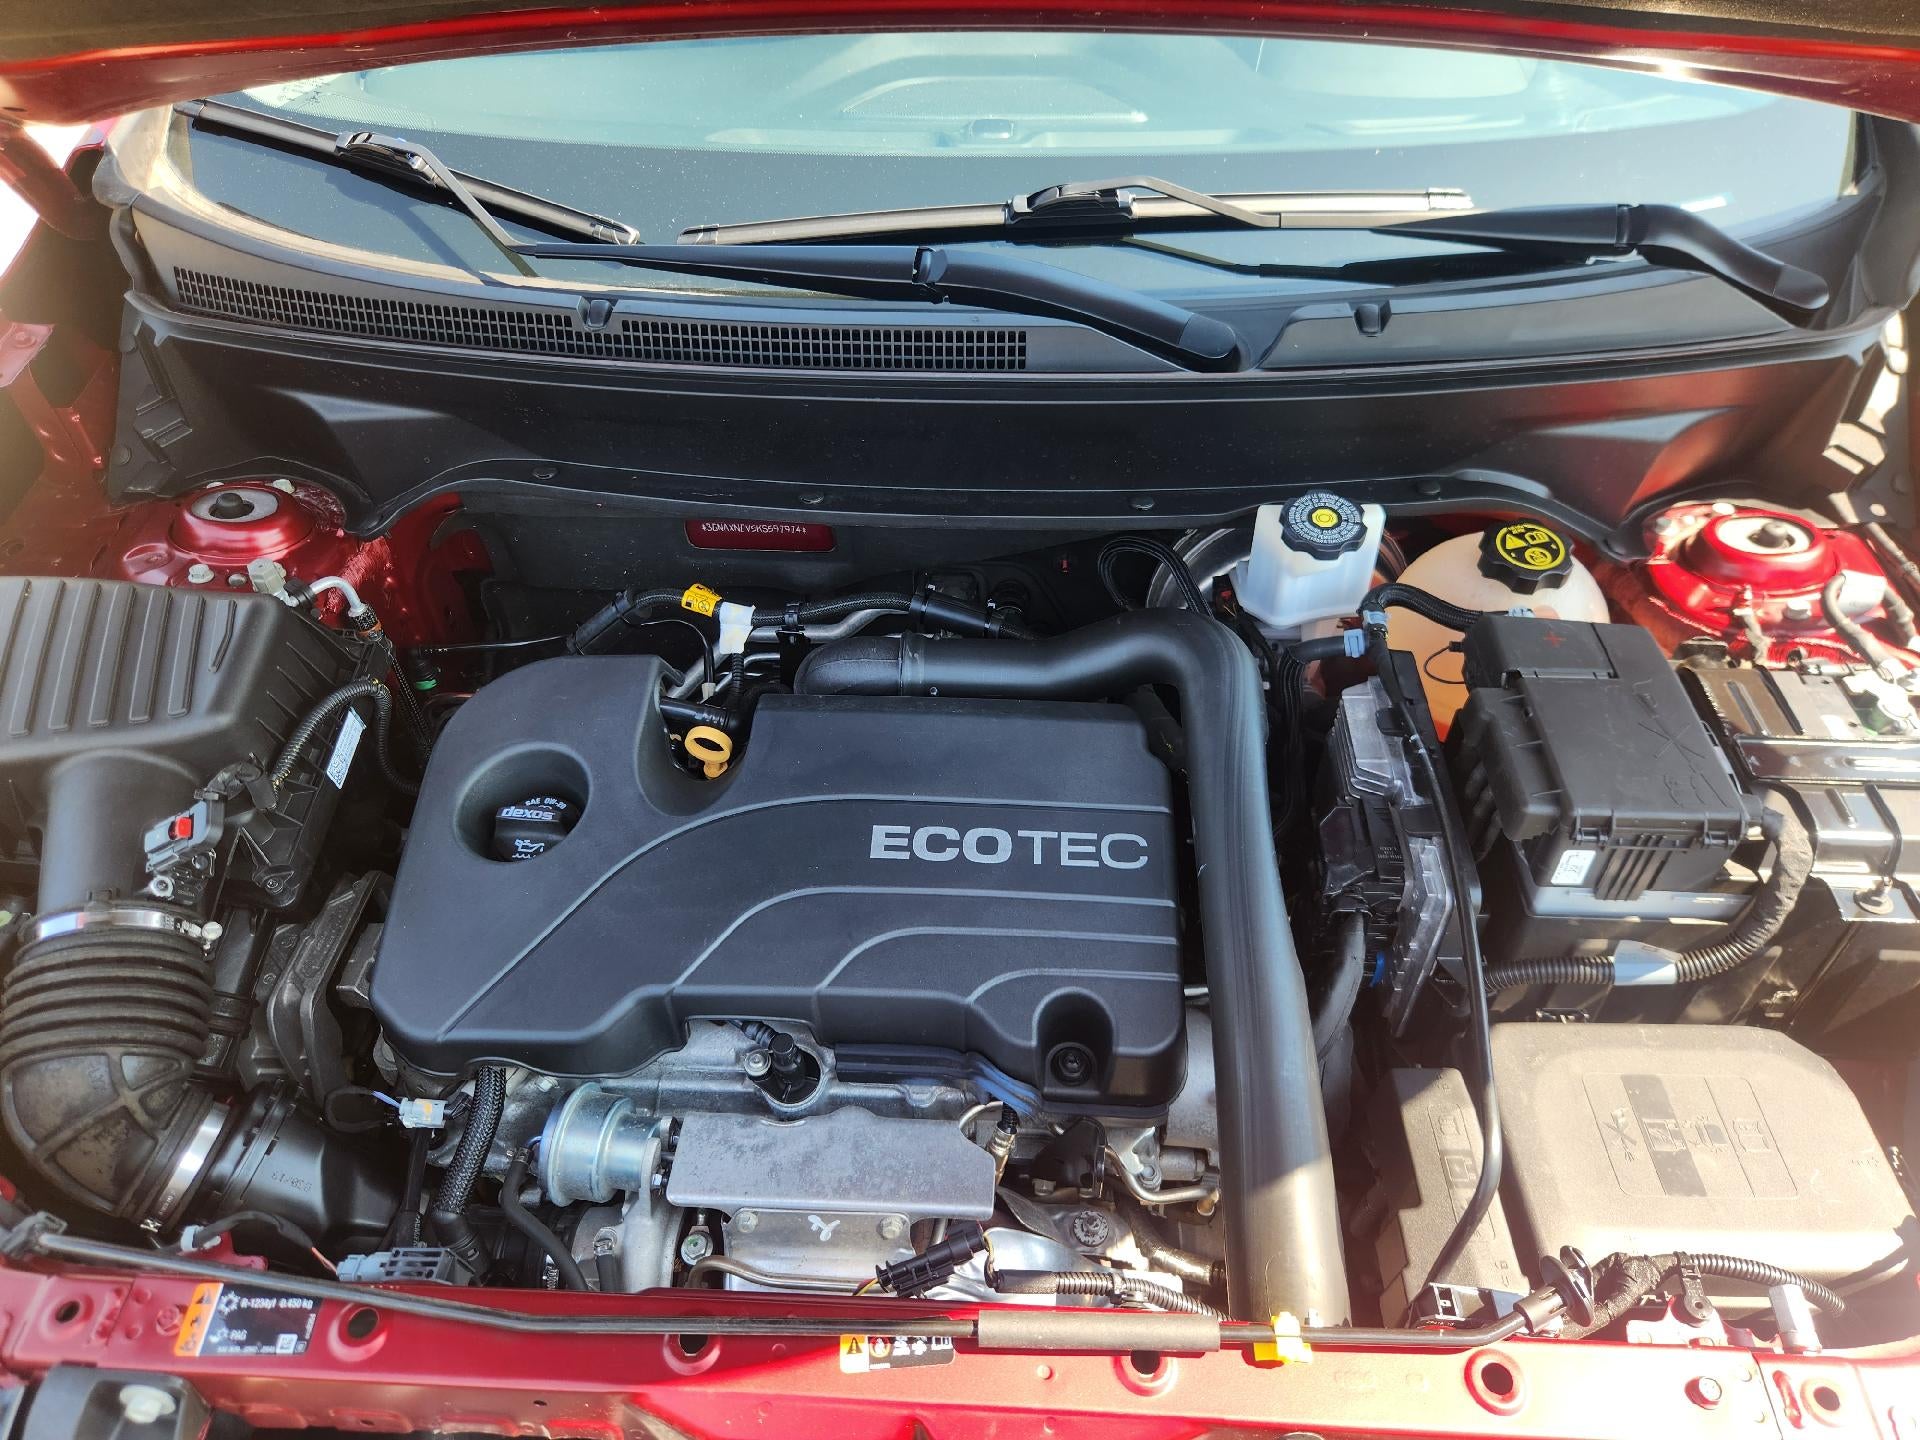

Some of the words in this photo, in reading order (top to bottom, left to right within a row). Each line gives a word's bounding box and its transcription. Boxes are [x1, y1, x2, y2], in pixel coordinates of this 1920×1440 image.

[525, 798, 541, 806] SAE
[544, 797, 567, 809] 0W-20
[501, 806, 553, 820] dexos
[870, 825, 1148, 869] ECOTEC
